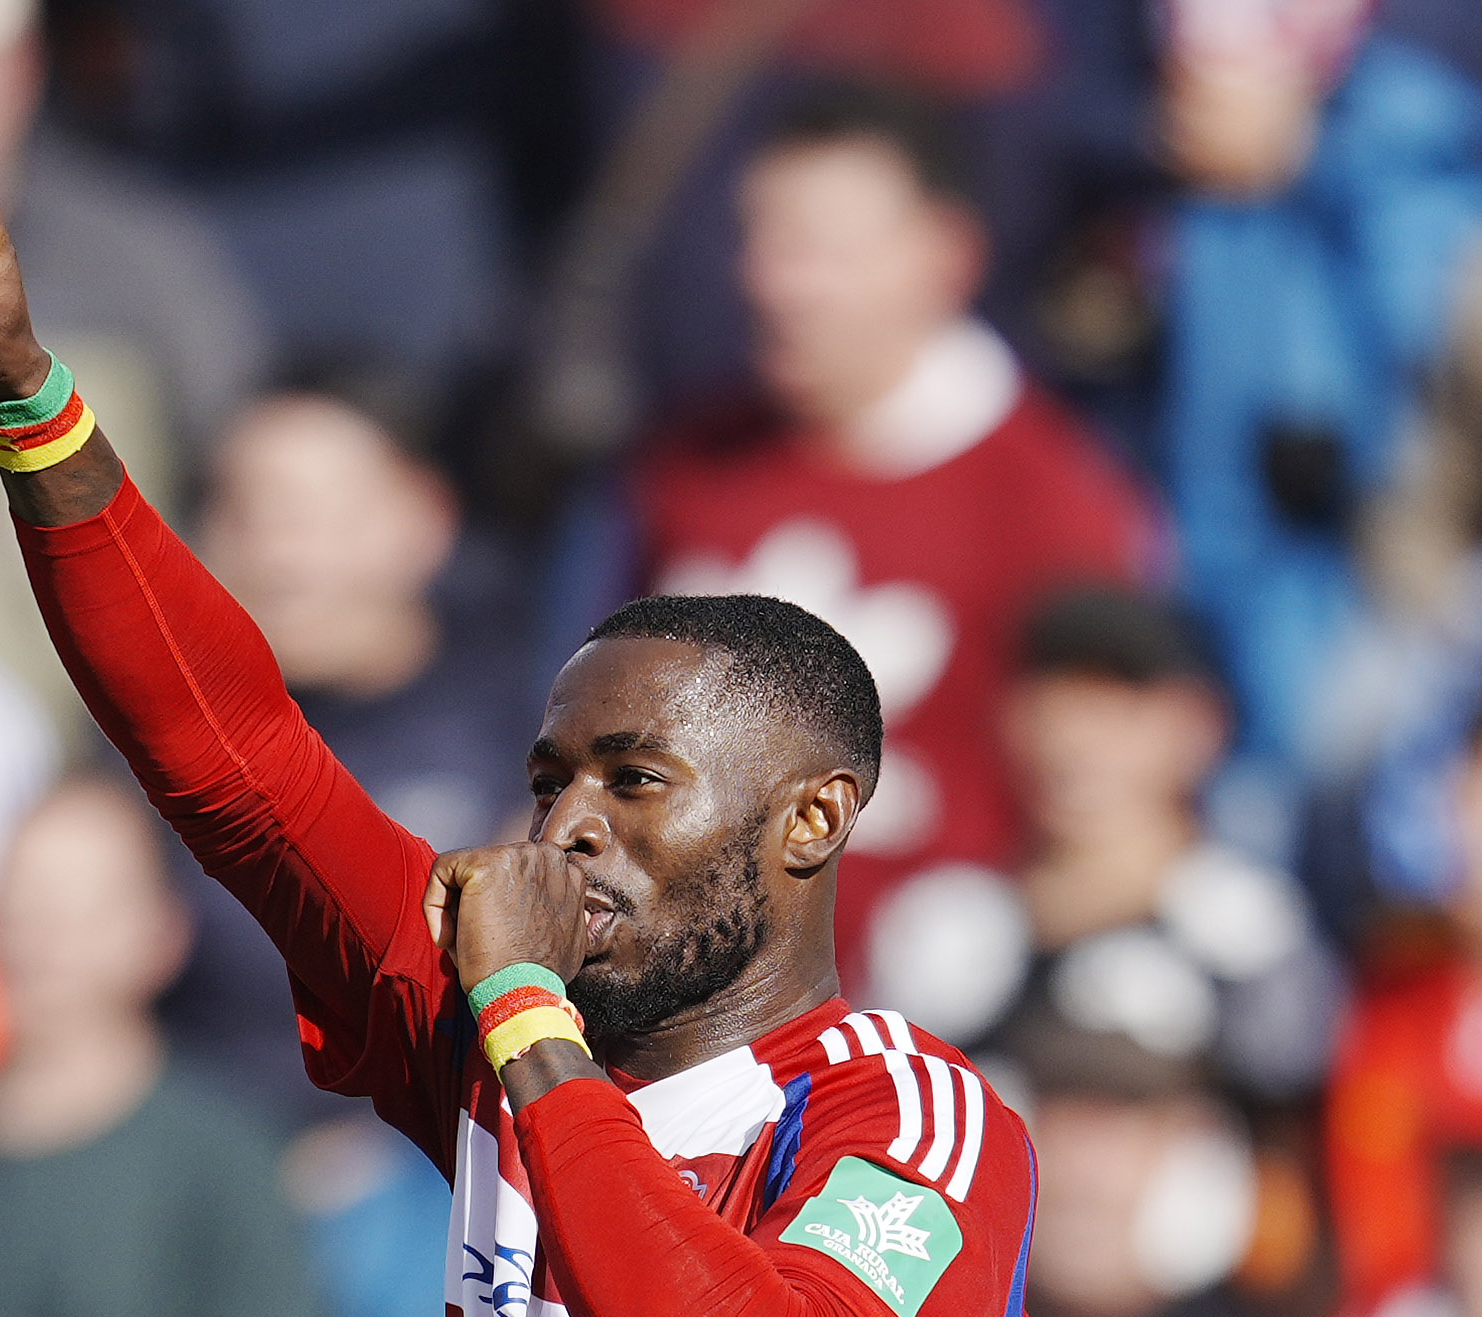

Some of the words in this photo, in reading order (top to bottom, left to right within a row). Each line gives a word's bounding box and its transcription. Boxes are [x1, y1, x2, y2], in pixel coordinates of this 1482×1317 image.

[804, 1223, 851, 1248] CAJA
[854, 1242, 906, 1305] RURAL
[823, 1238, 885, 1291] GRANADA
